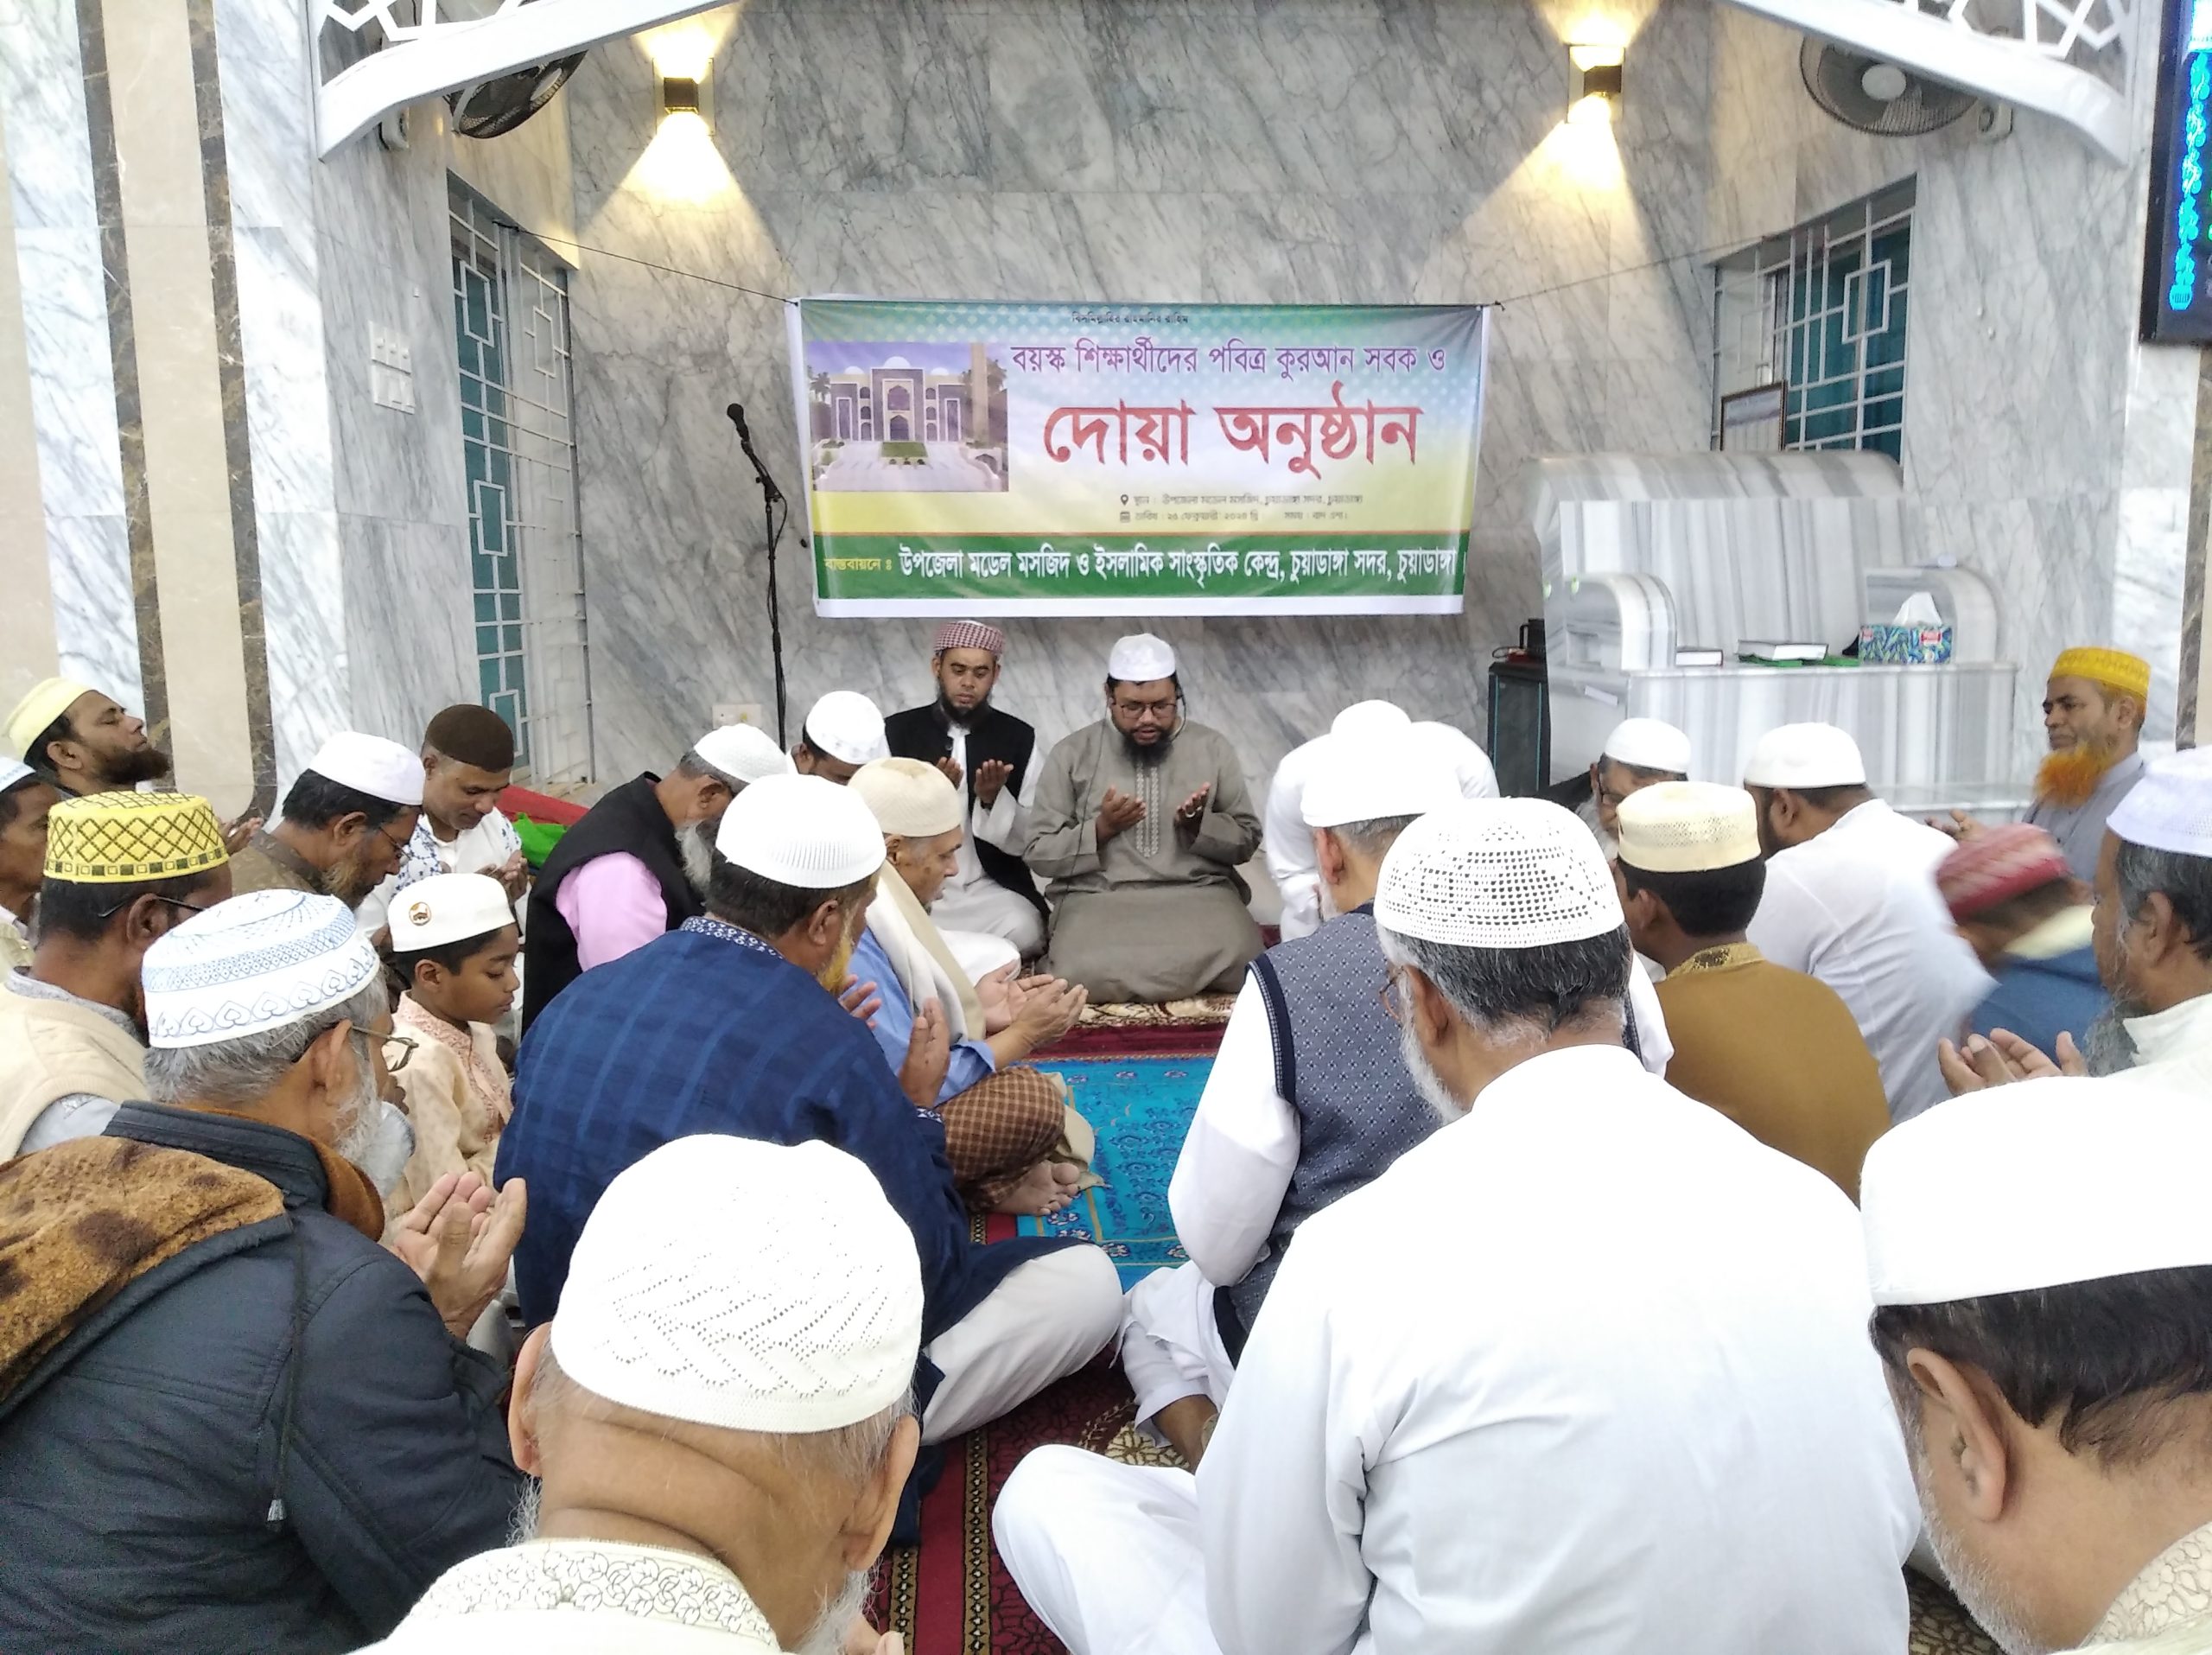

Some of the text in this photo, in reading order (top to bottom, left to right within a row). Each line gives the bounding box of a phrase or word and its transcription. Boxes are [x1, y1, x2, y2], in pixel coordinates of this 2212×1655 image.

[1010, 336, 1446, 382] বয়স্ক শিক্ষার্থীদের পবিত্র কুরআন সবক ও
[1043, 379, 1425, 481] দোয়া অনুষ্ঠান
[823, 557, 881, 571] বাস্তবায়নে
[899, 543, 965, 579] উপজেলা
[968, 551, 1013, 578] মডেল
[1016, 542, 1071, 579] মসজিদ
[1077, 553, 1090, 576] ও
[1094, 543, 1165, 580] ইসলামিক
[1168, 542, 1239, 589] সাংস্কৃতিক
[1243, 551, 1286, 582] কেন্দ্র,
[1289, 548, 1350, 585] চুয়াডাঙ্গা
[1352, 550, 1393, 582] সদর,
